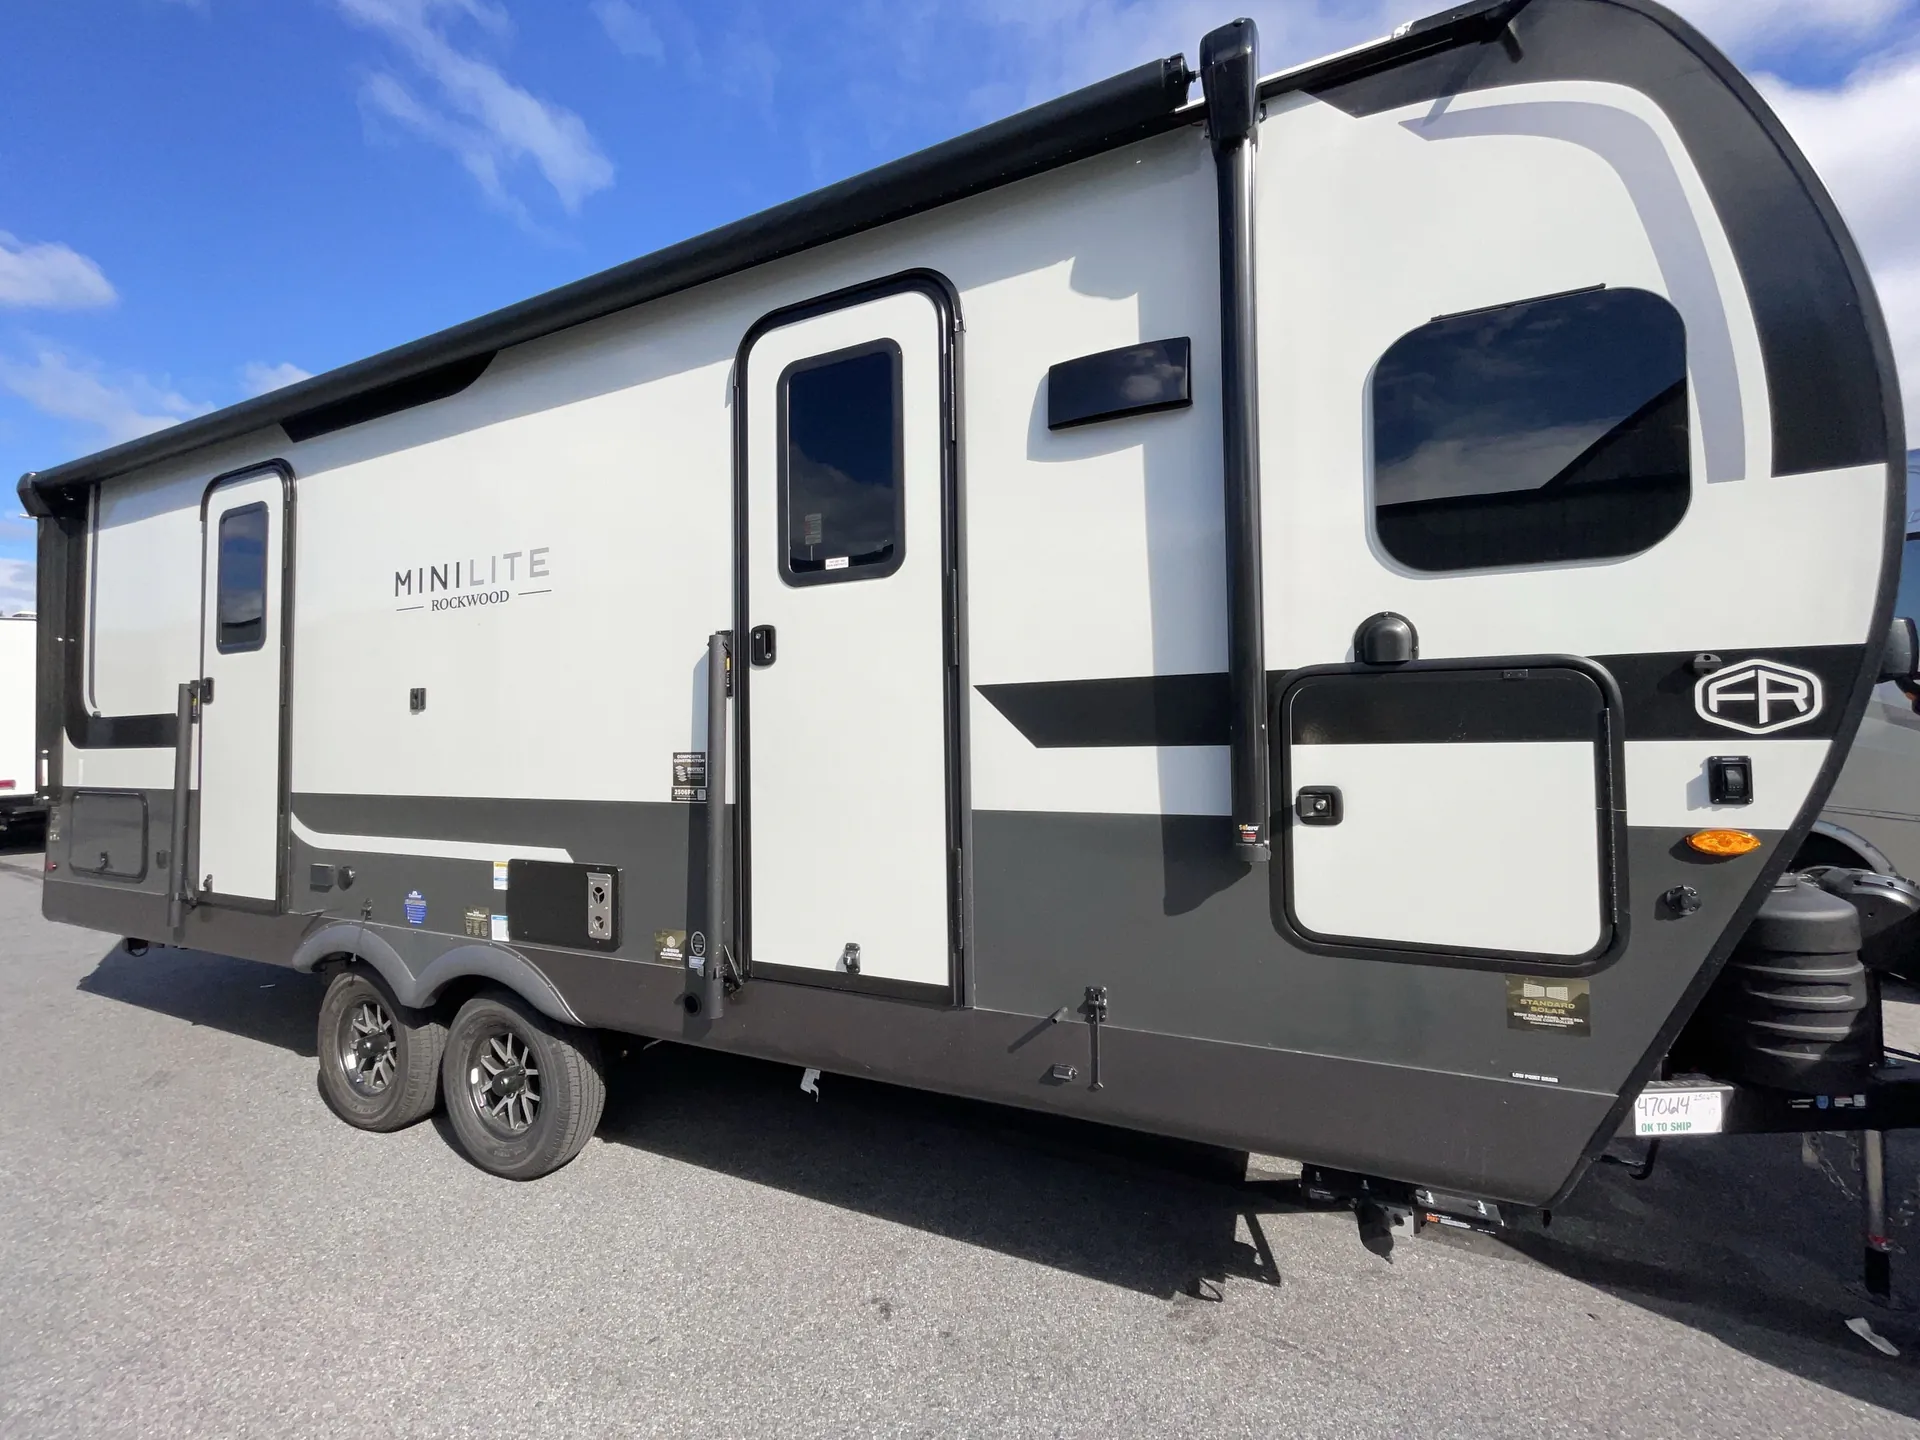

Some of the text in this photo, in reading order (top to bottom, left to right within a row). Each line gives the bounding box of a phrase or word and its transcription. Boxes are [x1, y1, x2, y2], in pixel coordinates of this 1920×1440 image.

[431, 590, 510, 611] ROCKWOOD
[1520, 998, 1576, 1010] STANDARD
[1530, 1006, 1566, 1015] SOLAR
[1641, 1121, 1692, 1132] OK TO SHIP
